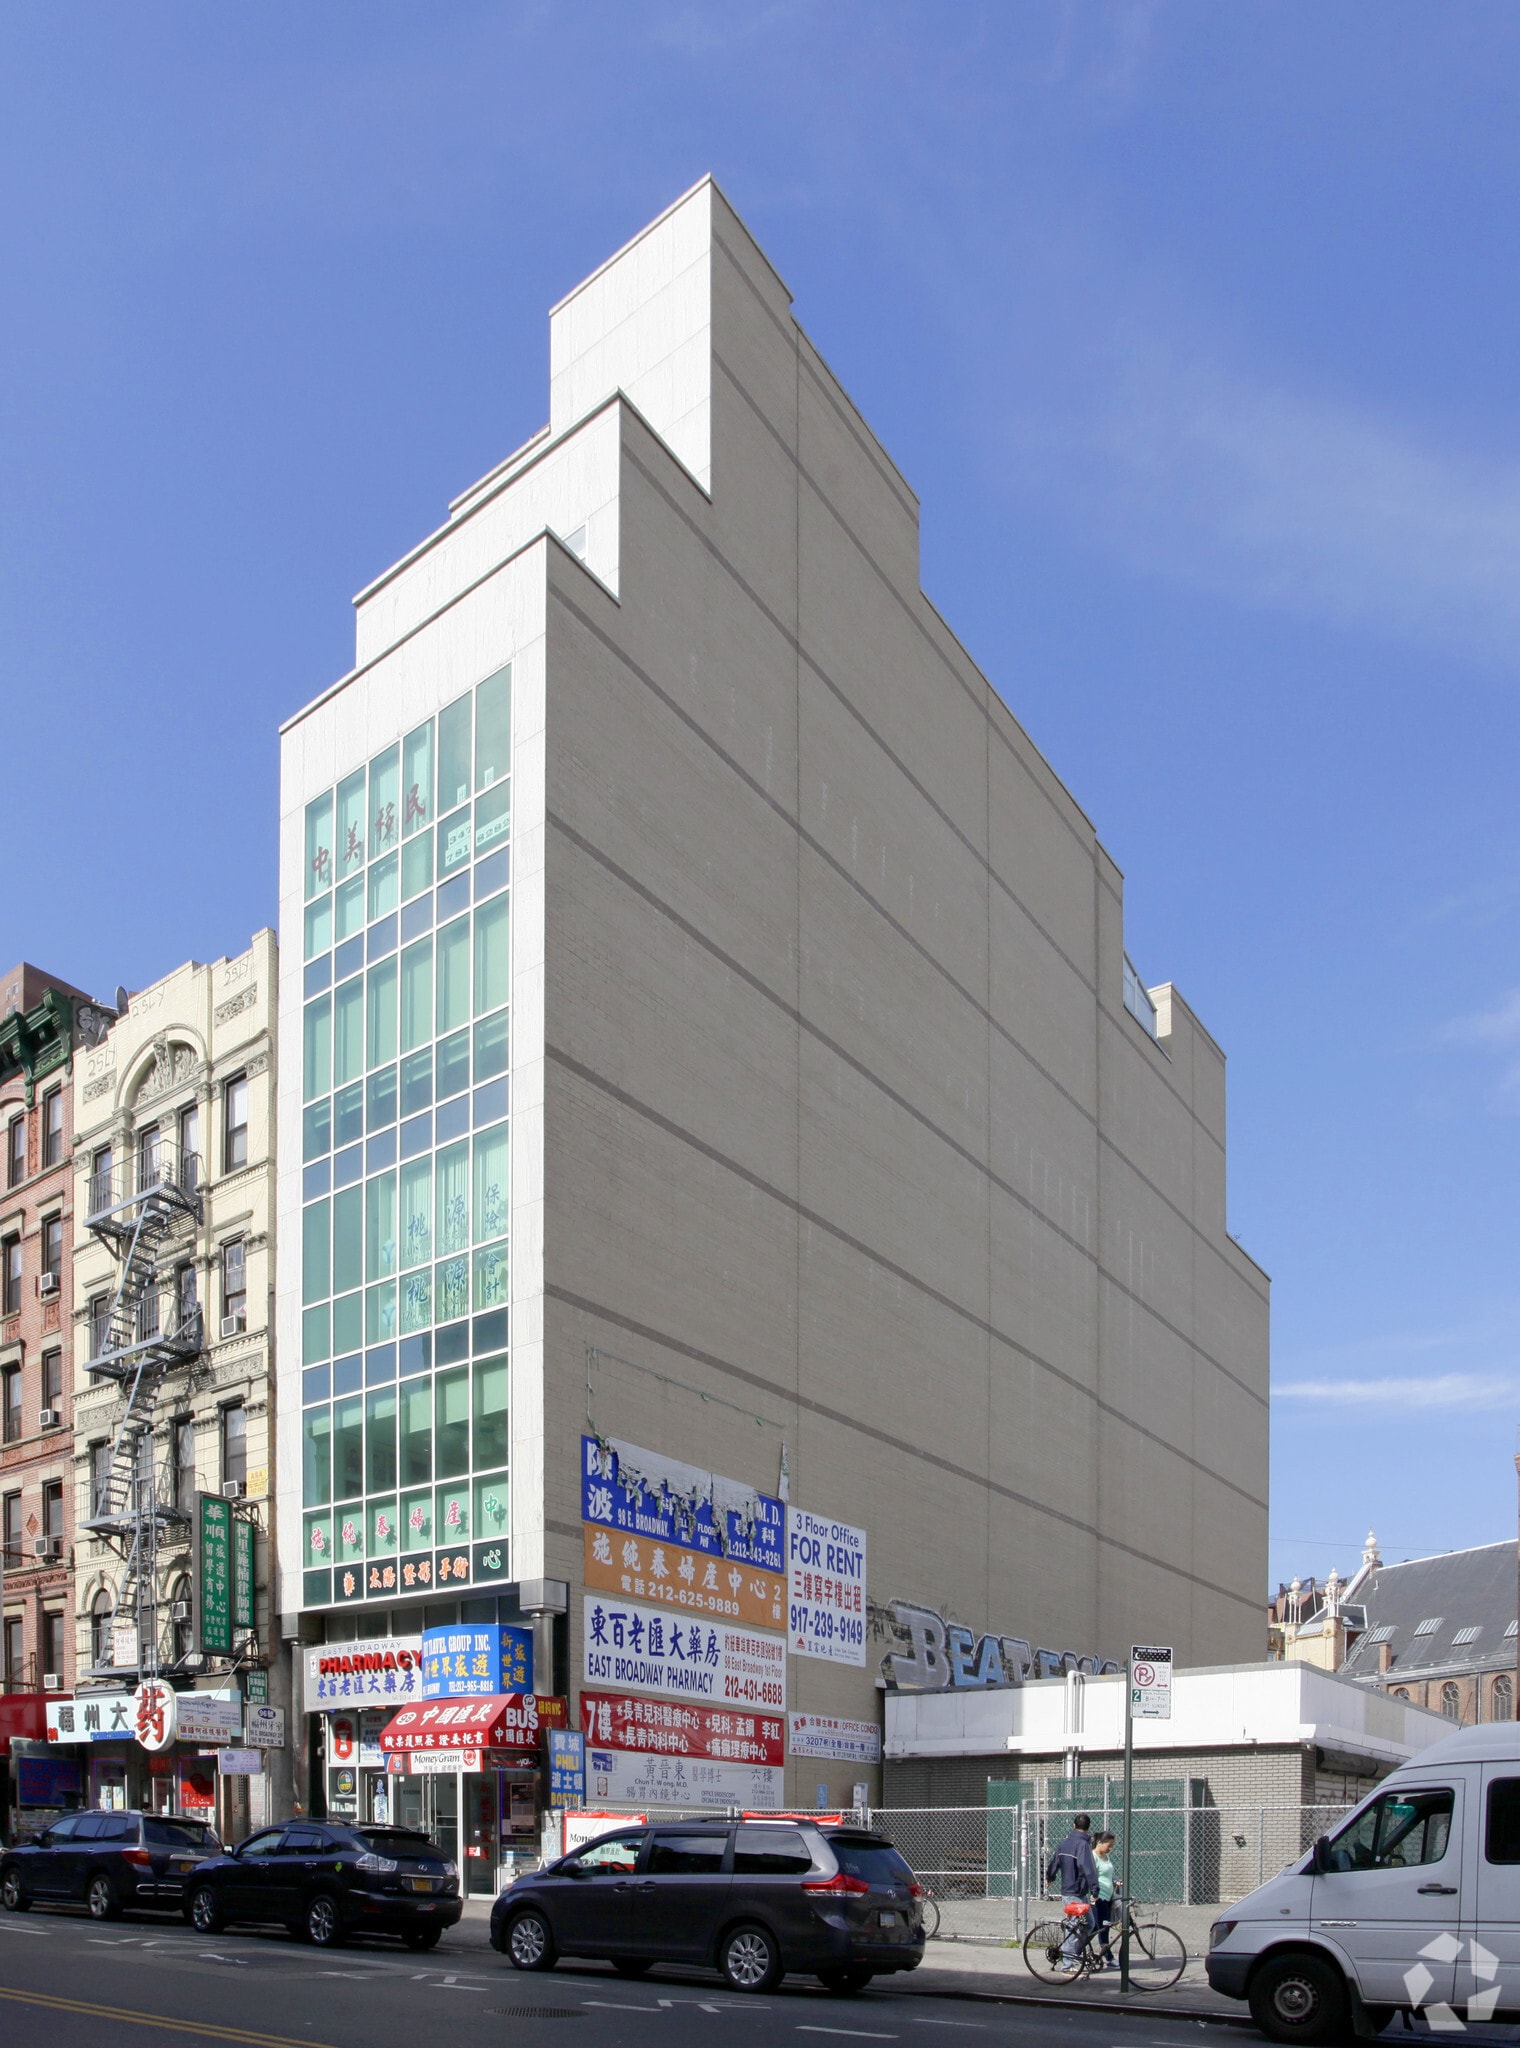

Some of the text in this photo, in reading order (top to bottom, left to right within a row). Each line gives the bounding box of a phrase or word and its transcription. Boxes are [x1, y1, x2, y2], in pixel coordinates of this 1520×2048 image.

[312, 783, 426, 882] 中美移民
[617, 1508, 626, 1526] 98
[635, 1514, 670, 1537] BROADWAY.
[796, 1513, 860, 1548] 3 Floor Office
[790, 1532, 863, 1579] FOR RENT
[369, 1555, 469, 1590] 太陽整形手術
[648, 1581, 740, 1616] 212-625-9889
[590, 1604, 721, 1668] 東百老匯大藥房
[790, 1604, 863, 1646] 917-239-9149
[322, 1641, 402, 1656] EAST BROADWAY
[448, 1634, 472, 1653] GROUP
[474, 1633, 491, 1652] INC.
[319, 1650, 422, 1676] PHARMACY
[424, 1653, 490, 1680] 新世界旅遊
[588, 1652, 714, 1694] EAST BROADWAY PHARMACY
[317, 1671, 416, 1699] 東百老匯大藥房
[724, 1674, 783, 1705] 212-431-6688
[1133, 1690, 1140, 1701] 2
[506, 1707, 539, 1730] BUS
[554, 1733, 580, 1752] 費城
[414, 1753, 461, 1765] MoneyGram
[555, 1753, 580, 1771] PHILI
